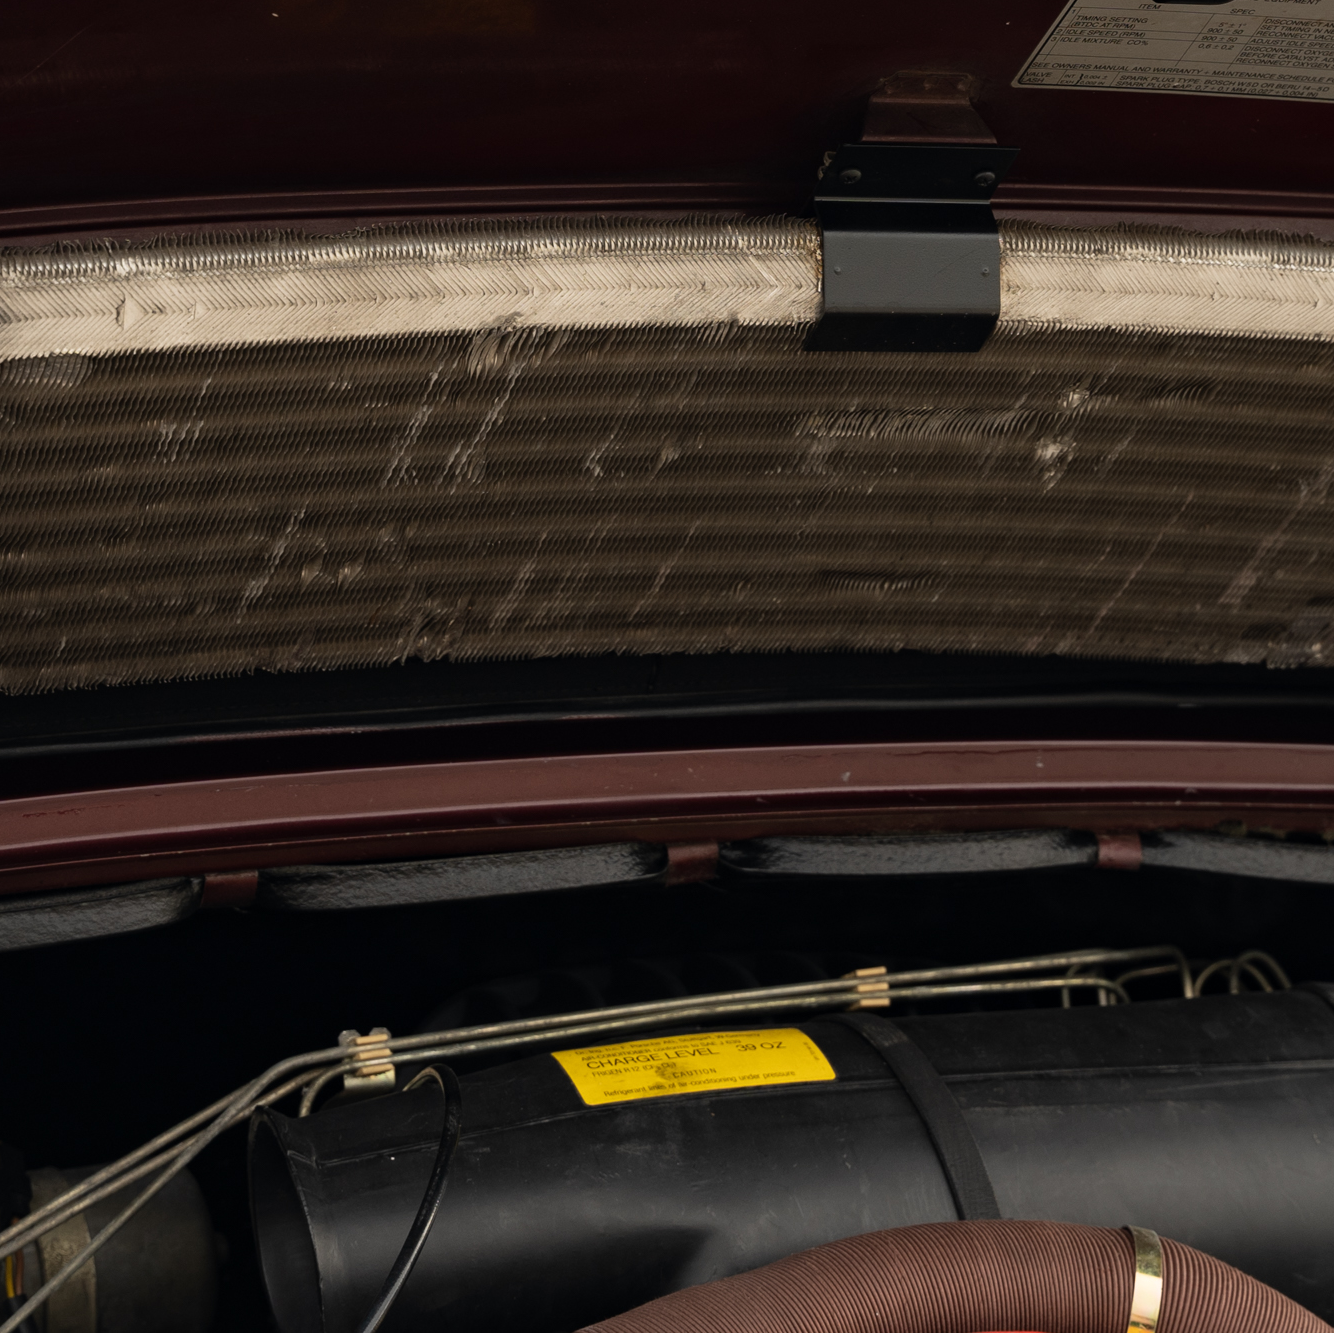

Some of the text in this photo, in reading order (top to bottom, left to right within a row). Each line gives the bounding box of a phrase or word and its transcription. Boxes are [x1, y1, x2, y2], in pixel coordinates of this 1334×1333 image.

[1264, 18, 1323, 27] DISCONNECT
[1254, 30, 1313, 39] RECONNECT
[1249, 37, 1285, 45] ADJUST
[1243, 45, 1302, 54] DISCONNECT
[1239, 51, 1278, 59] BEFORE
[1234, 57, 1293, 66] RECONNECT
[1211, 70, 1277, 78] MAINTENANCE
[1276, 74, 1326, 82] SCHEDULE
[587, 1053, 662, 1069] CHARGE
[664, 1047, 720, 1059] LEVEL
[736, 1043, 756, 1052] 39
[760, 1041, 786, 1050] OZ
[592, 1068, 622, 1077] FRIGEN
[673, 1068, 717, 1079] CAUTION
[604, 1085, 646, 1098] Refrigerant
[678, 1076, 737, 1087] air-conditioning
[738, 1073, 760, 1081] under
[763, 1071, 796, 1081] pressure
